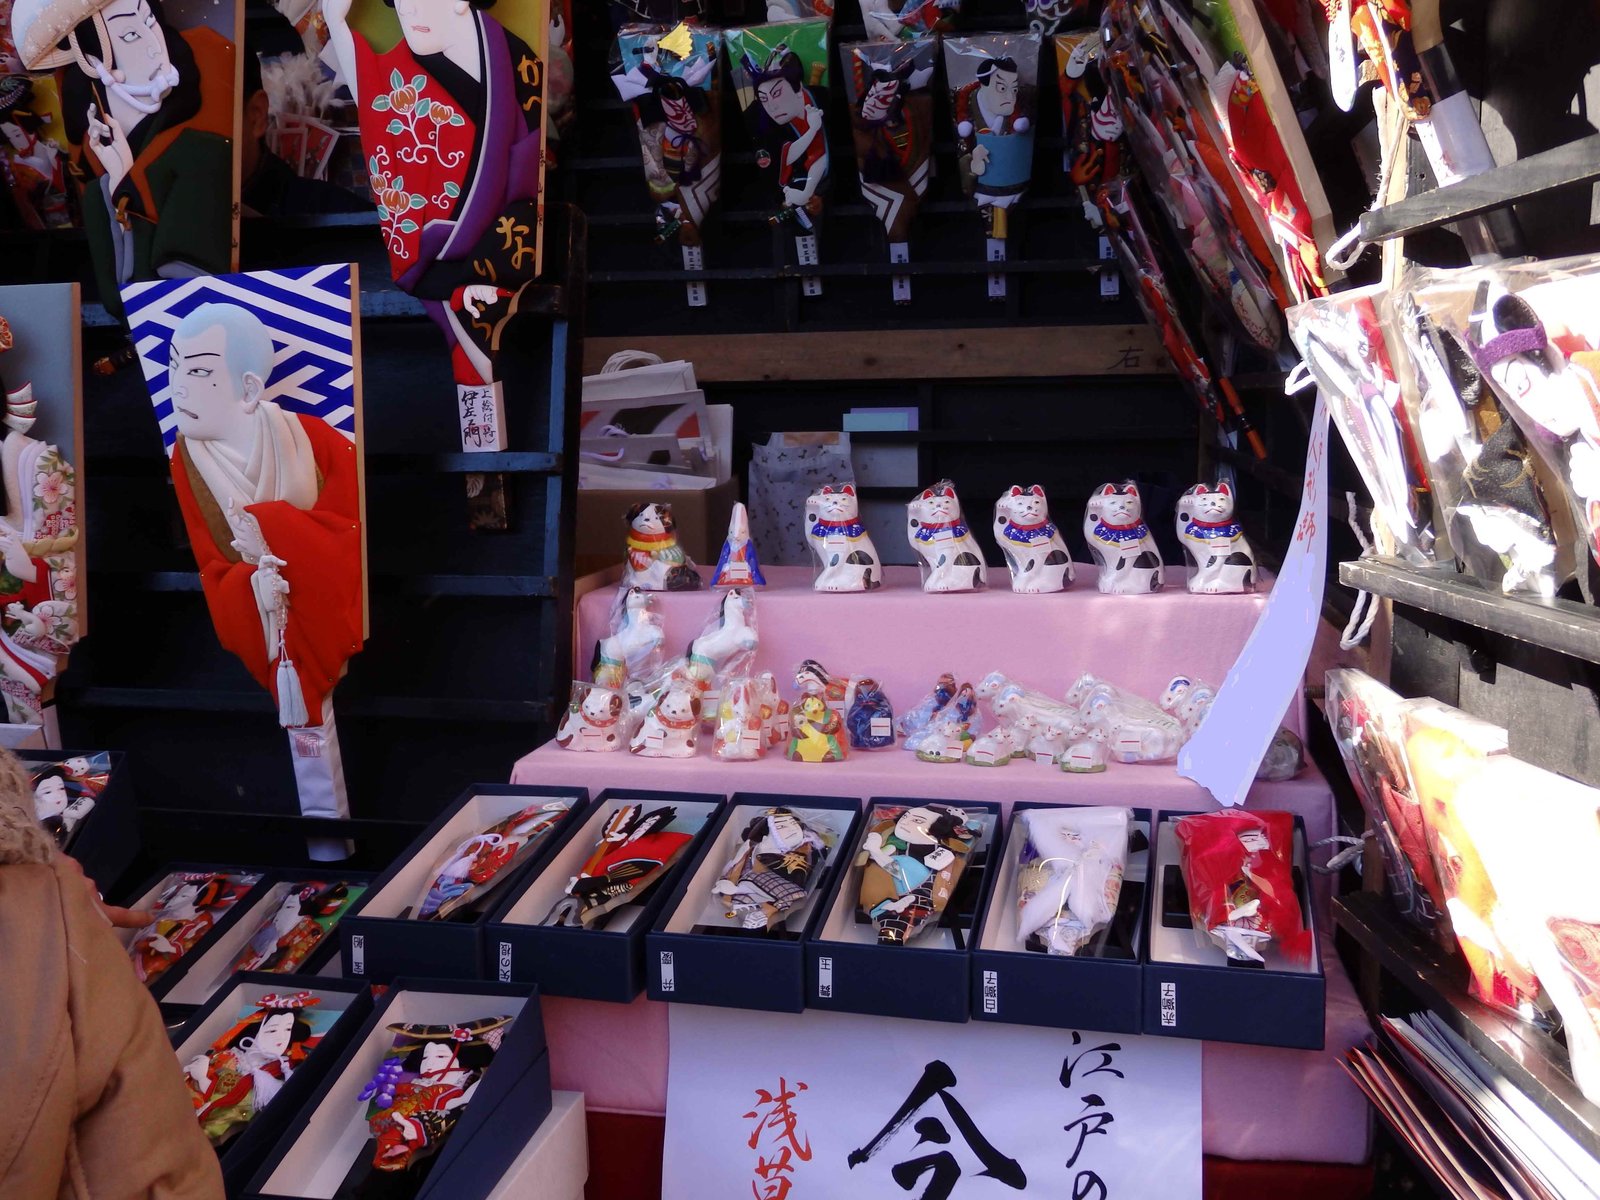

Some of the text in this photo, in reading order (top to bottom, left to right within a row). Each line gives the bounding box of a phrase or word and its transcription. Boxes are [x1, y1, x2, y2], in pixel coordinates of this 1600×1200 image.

[1107, 345, 1144, 370] 右
[353, 937, 363, 973] 宝船
[500, 944, 510, 980] 矢の根
[662, 952, 673, 990] 弁慶
[985, 972, 997, 1011] 白獅子
[1162, 984, 1175, 1024] 赤獅子
[1058, 1032, 1124, 1200] 江戸の
